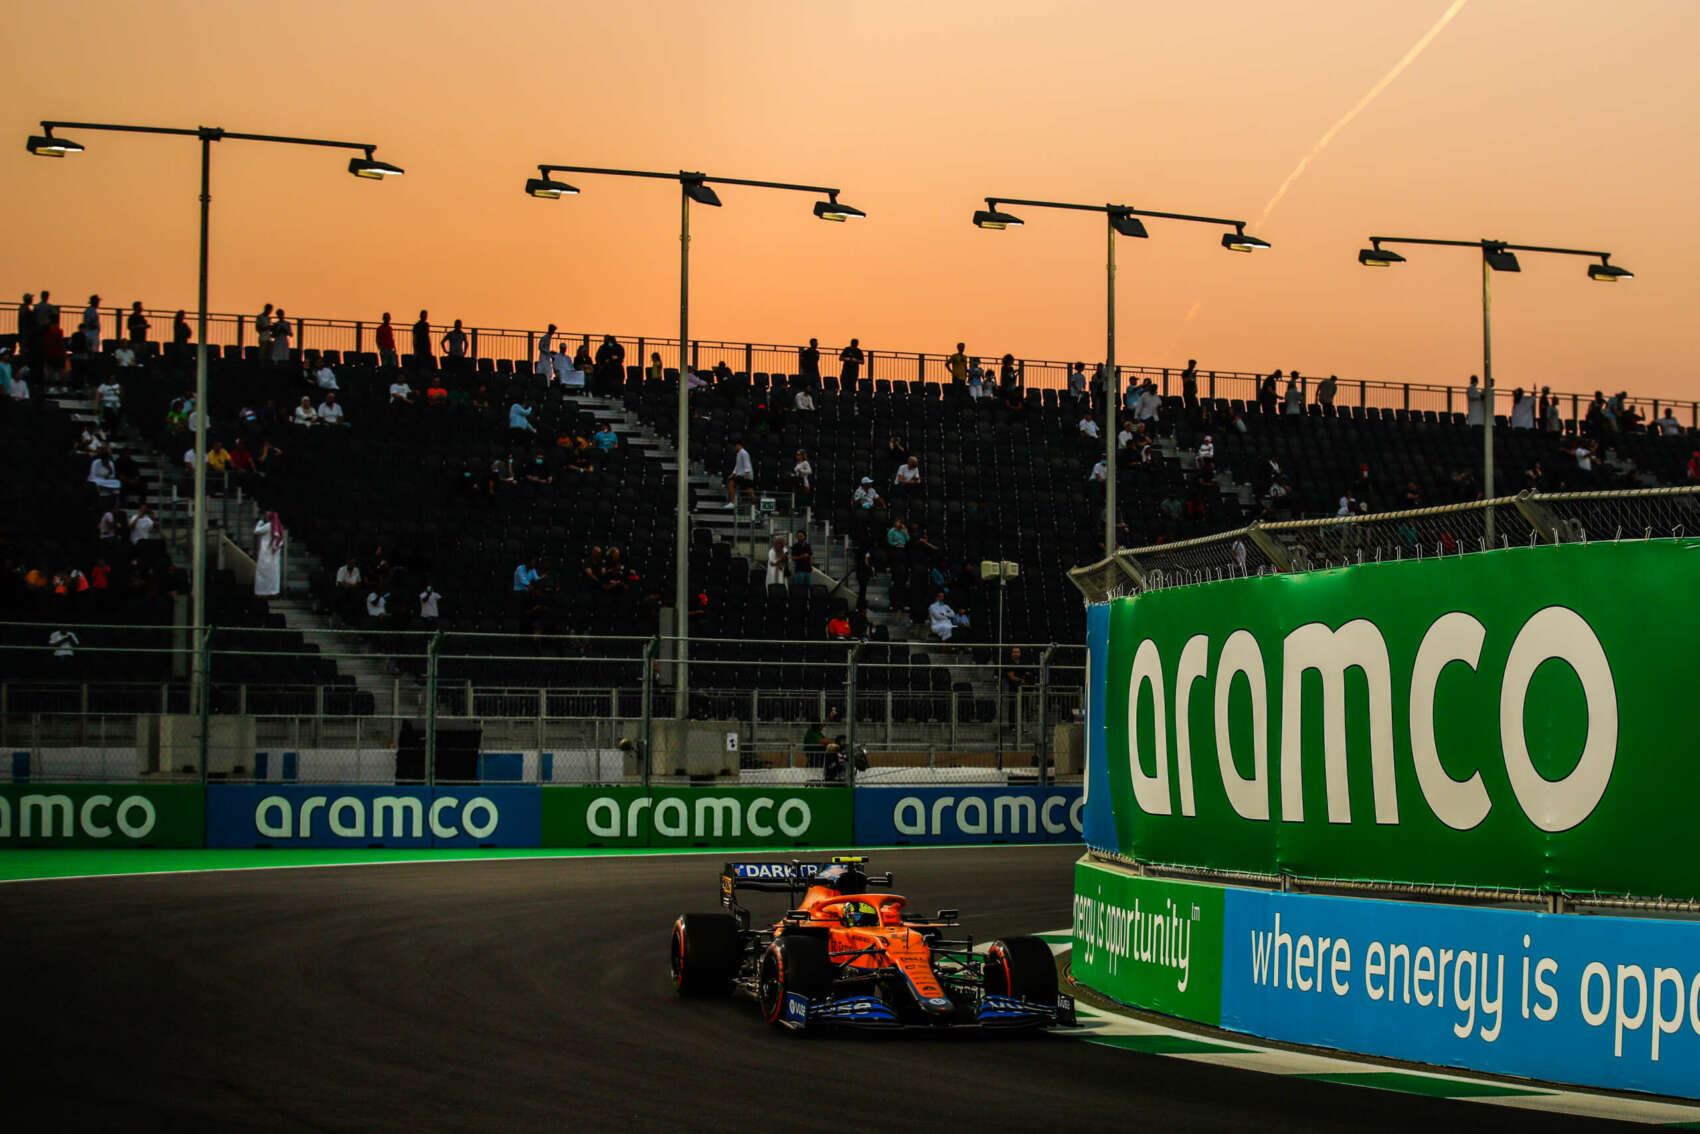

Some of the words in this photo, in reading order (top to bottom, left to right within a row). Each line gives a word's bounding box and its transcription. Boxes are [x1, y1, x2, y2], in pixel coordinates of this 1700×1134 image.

[1127, 605, 1619, 833] aramco
[255, 795, 499, 839] aramco
[585, 796, 812, 838] aramco
[1073, 893, 1097, 966] nergy
[1105, 897, 1191, 993] opportunity
[1251, 911, 1351, 996] where
[1365, 940, 1505, 1043] energy
[1521, 934, 1559, 1022] is
